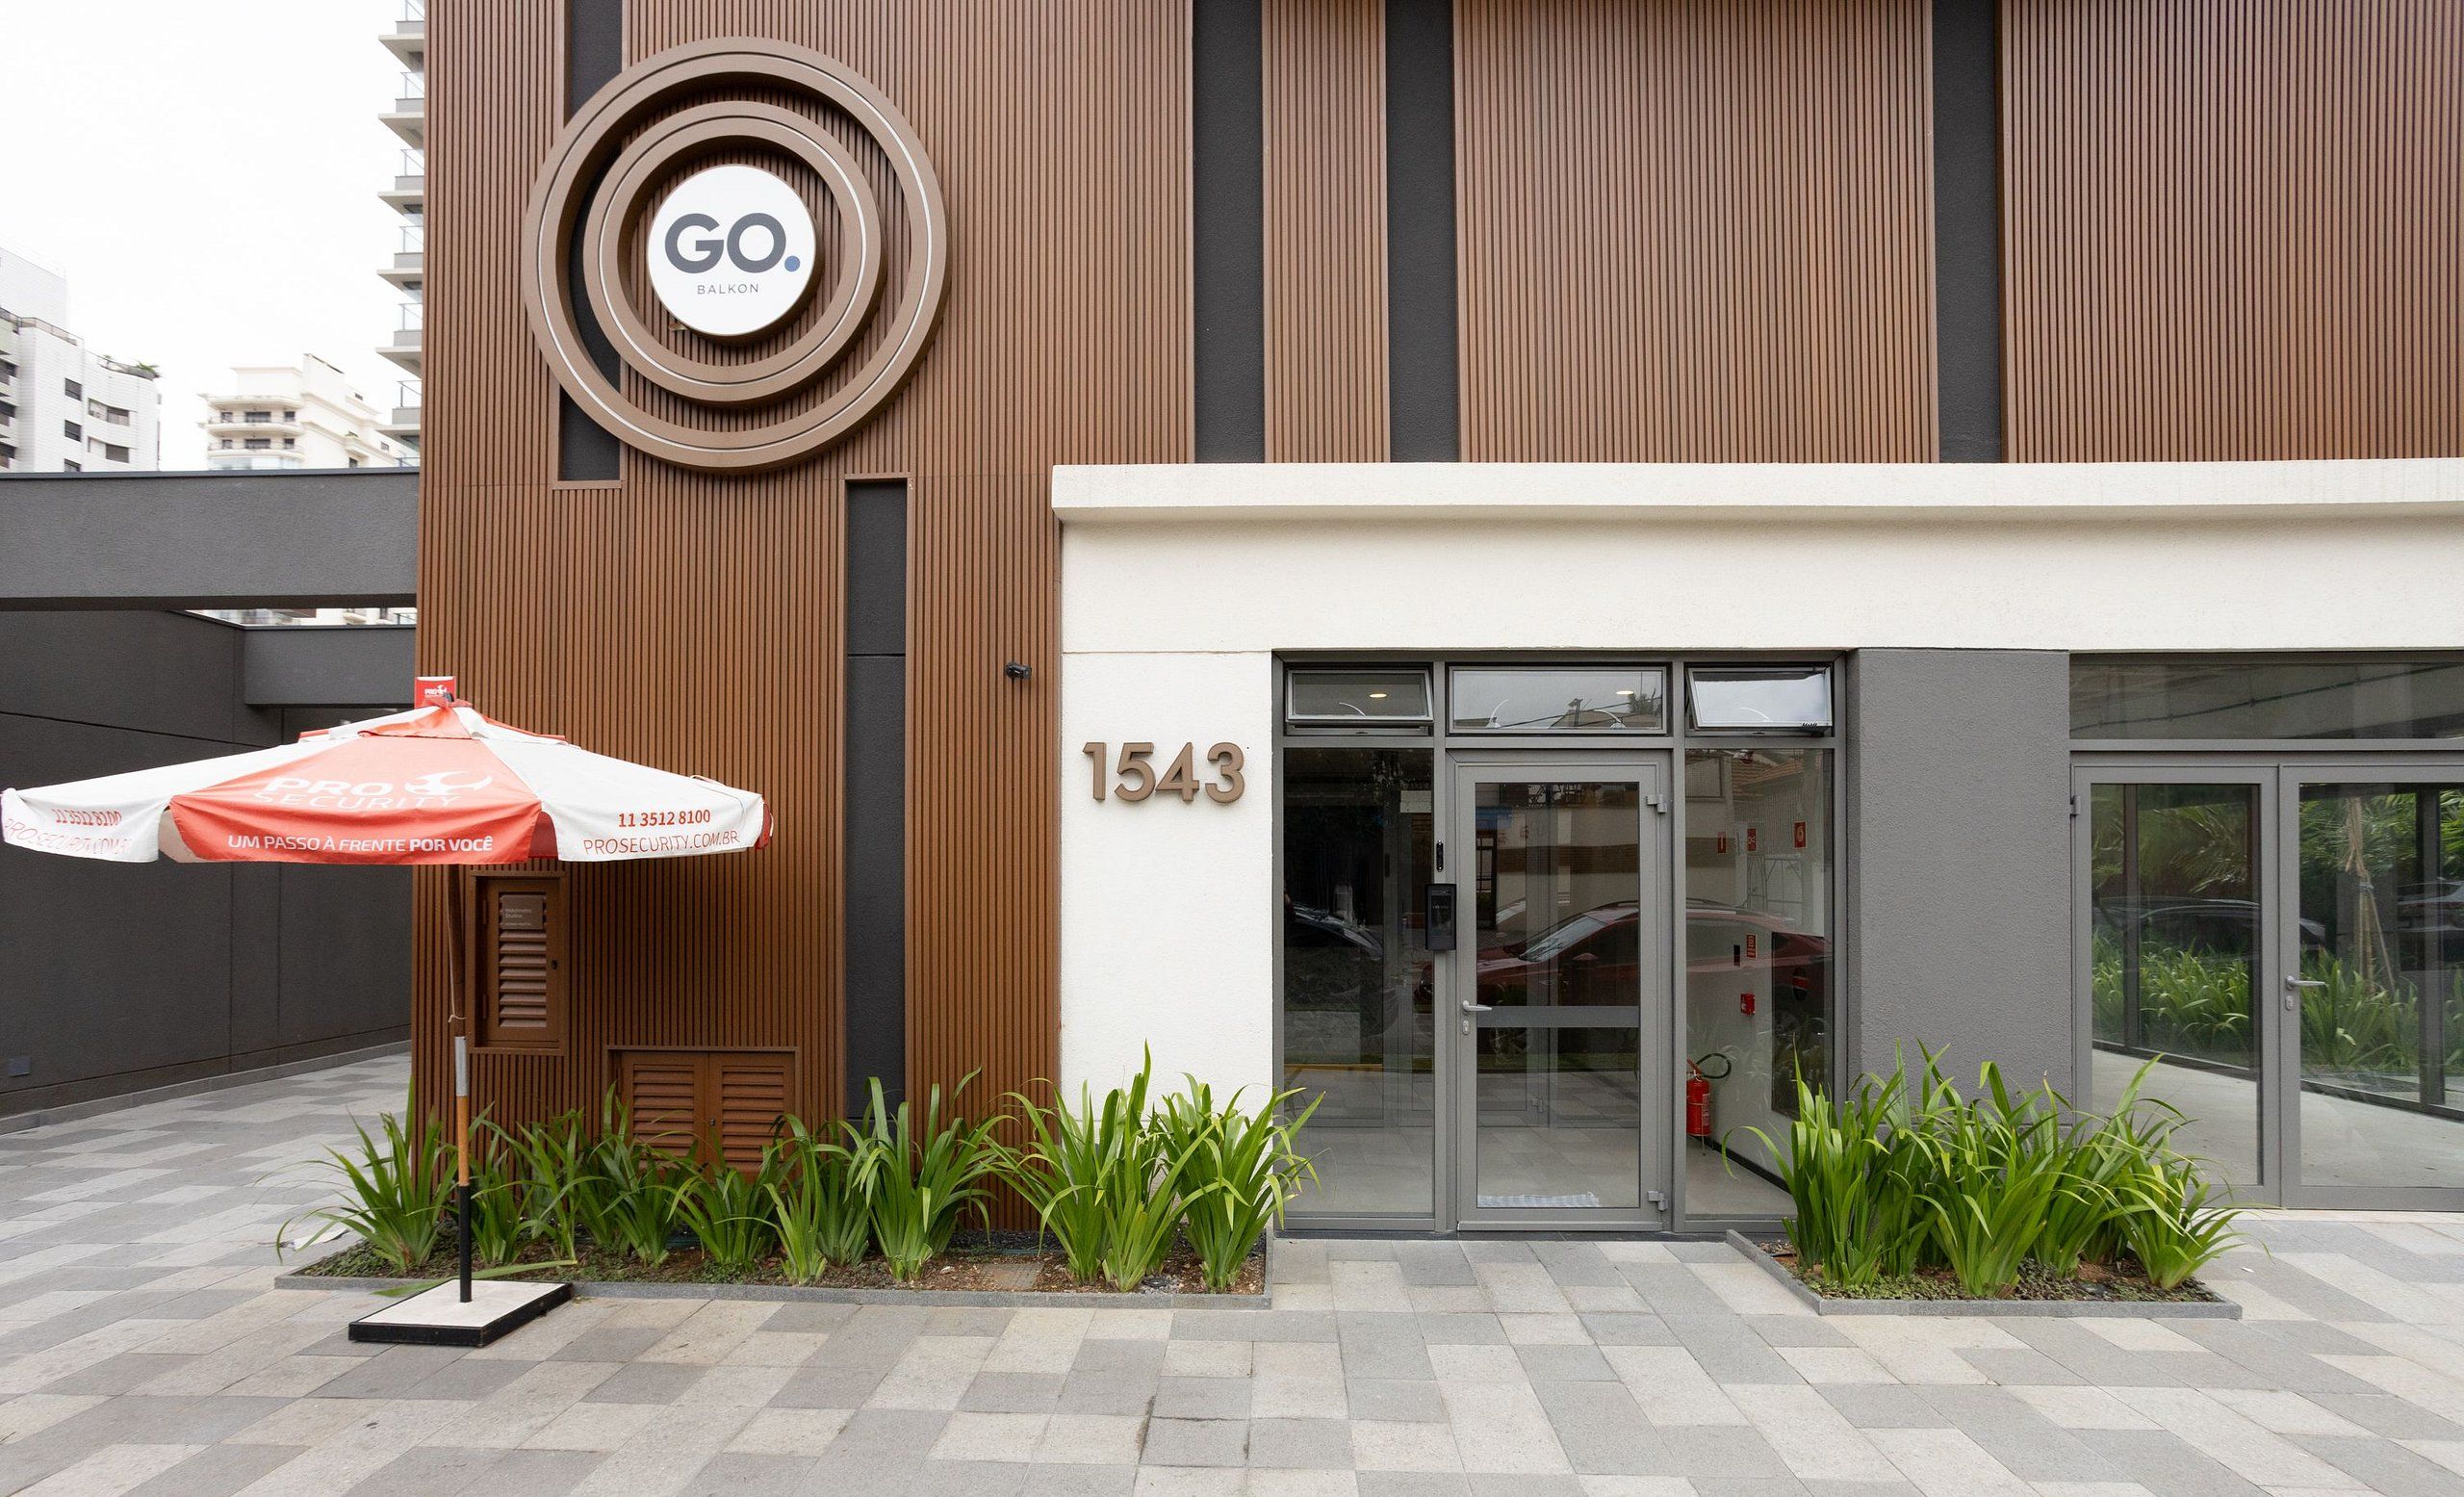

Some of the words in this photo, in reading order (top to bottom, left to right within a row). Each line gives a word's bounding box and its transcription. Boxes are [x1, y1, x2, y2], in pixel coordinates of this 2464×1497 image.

[697, 283, 759, 295] BALKON
[1082, 741, 1245, 804] 1543
[262, 777, 394, 797] PRO
[253, 792, 462, 810] SECURITY
[618, 813, 636, 828] 11
[639, 811, 675, 827] 3512
[679, 809, 711, 825] 8100
[228, 835, 260, 849] UM
[264, 836, 321, 851] PASSO
[322, 836, 337, 851] À
[339, 839, 407, 852] FRENTE
[409, 839, 447, 852] POR
[448, 835, 494, 852] VOCÊ
[582, 830, 741, 856] PROSECURITY.COM.BR
